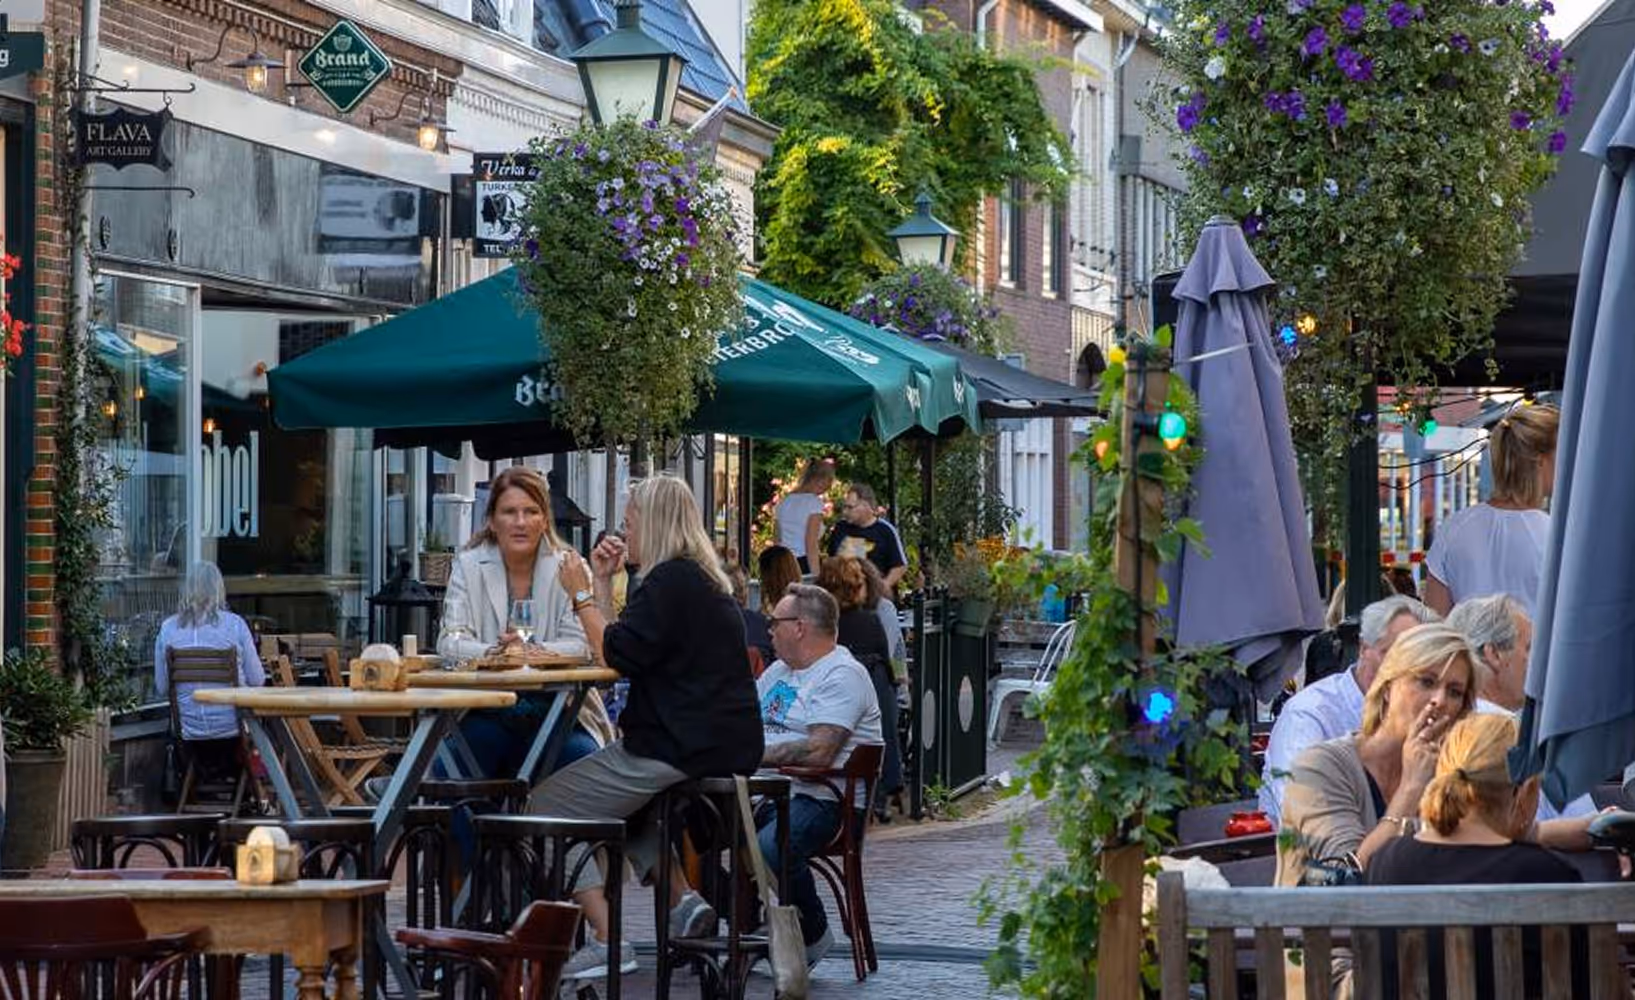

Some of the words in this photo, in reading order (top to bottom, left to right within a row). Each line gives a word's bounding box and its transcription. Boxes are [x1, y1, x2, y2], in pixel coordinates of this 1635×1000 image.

[315, 48, 370, 68] Brand
[87, 123, 151, 141] FLAVA
[86, 146, 105, 156] ART
[107, 146, 152, 156] GALLERY
[515, 374, 567, 408] Bra
